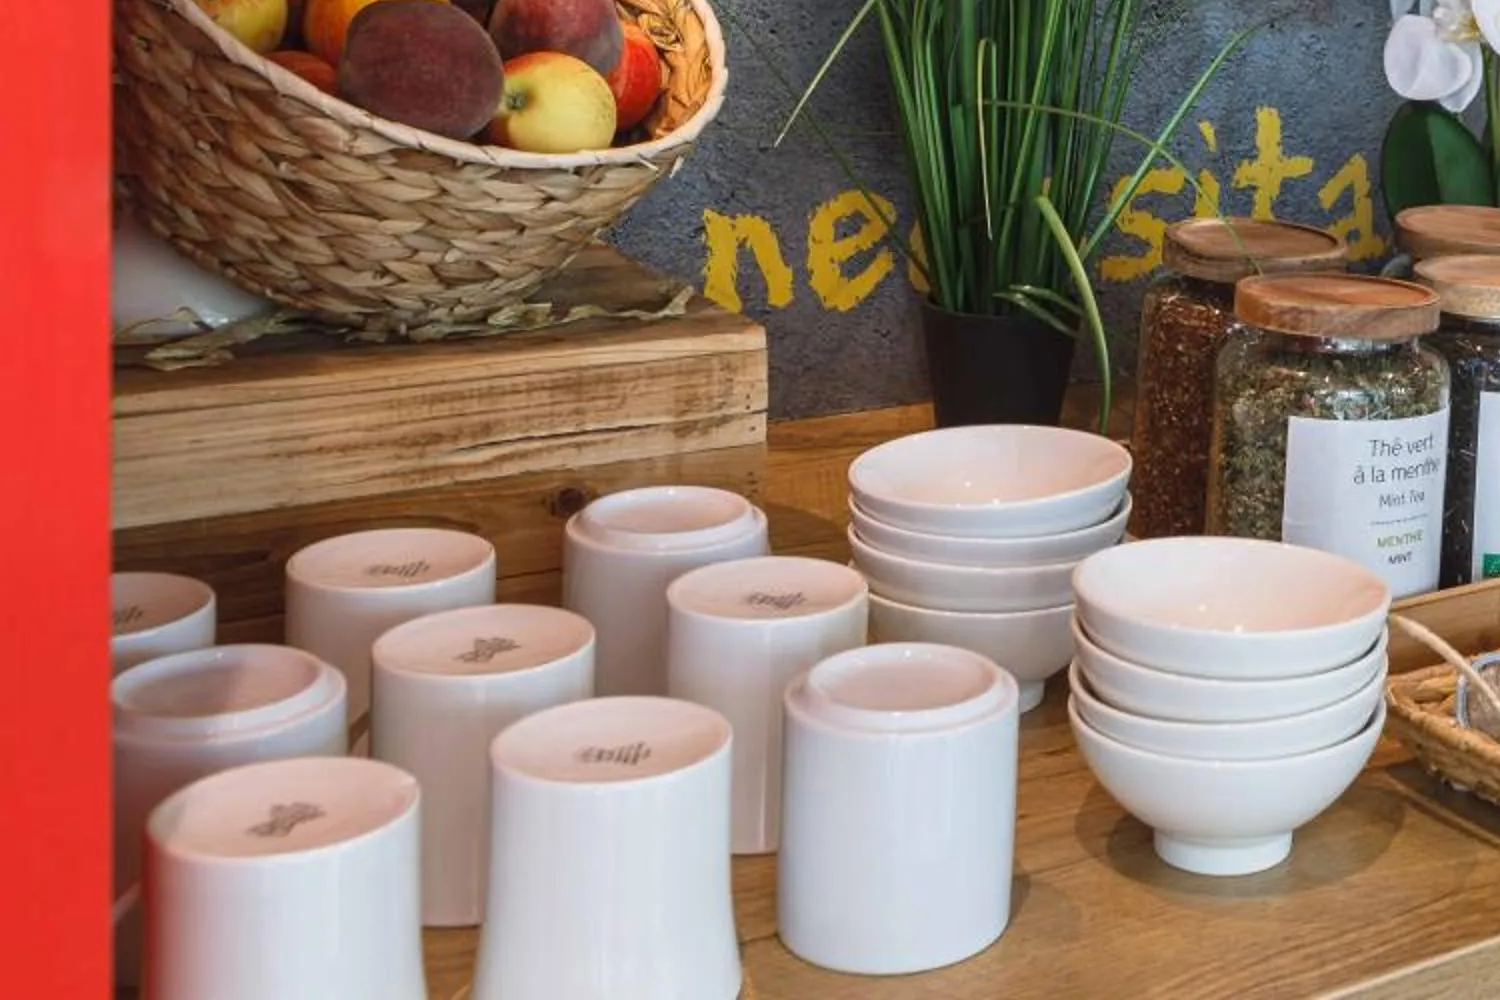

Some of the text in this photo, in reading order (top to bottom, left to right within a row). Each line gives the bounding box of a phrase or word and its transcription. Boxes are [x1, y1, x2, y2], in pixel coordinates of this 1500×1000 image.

[1369, 433, 1434, 457] Thé vert
[1371, 465, 1386, 484] la
